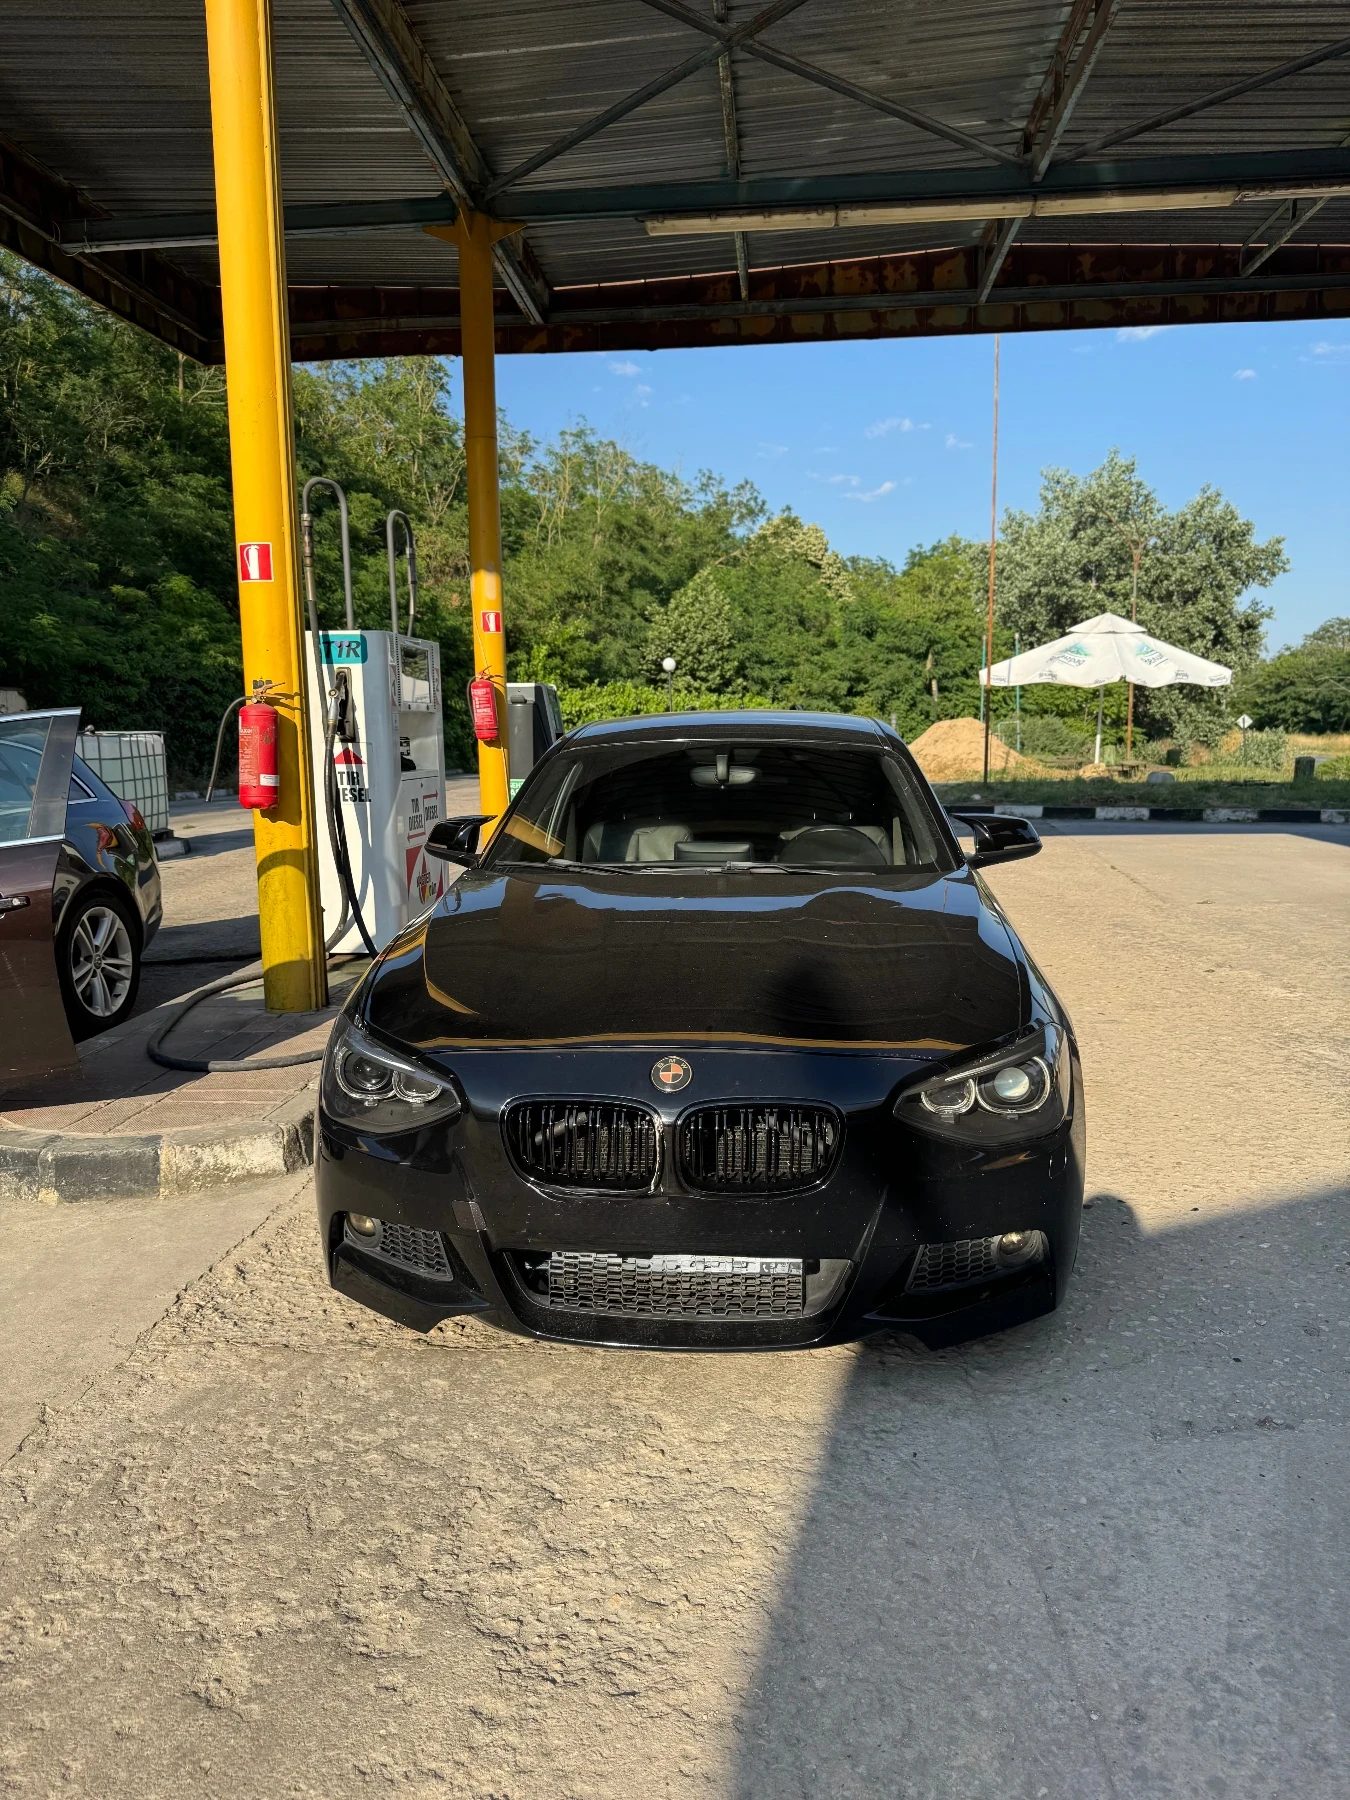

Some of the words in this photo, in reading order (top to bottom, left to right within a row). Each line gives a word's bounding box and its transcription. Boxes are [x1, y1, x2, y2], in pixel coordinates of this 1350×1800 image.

[322, 640, 361, 658] TIR
[338, 771, 360, 786] TIR
[341, 787, 372, 803] ESEL
[411, 798, 420, 813] TIR
[425, 804, 439, 821] DIESEL
[408, 814, 424, 831] DIESEL
[657, 1058, 688, 1069] BMW
